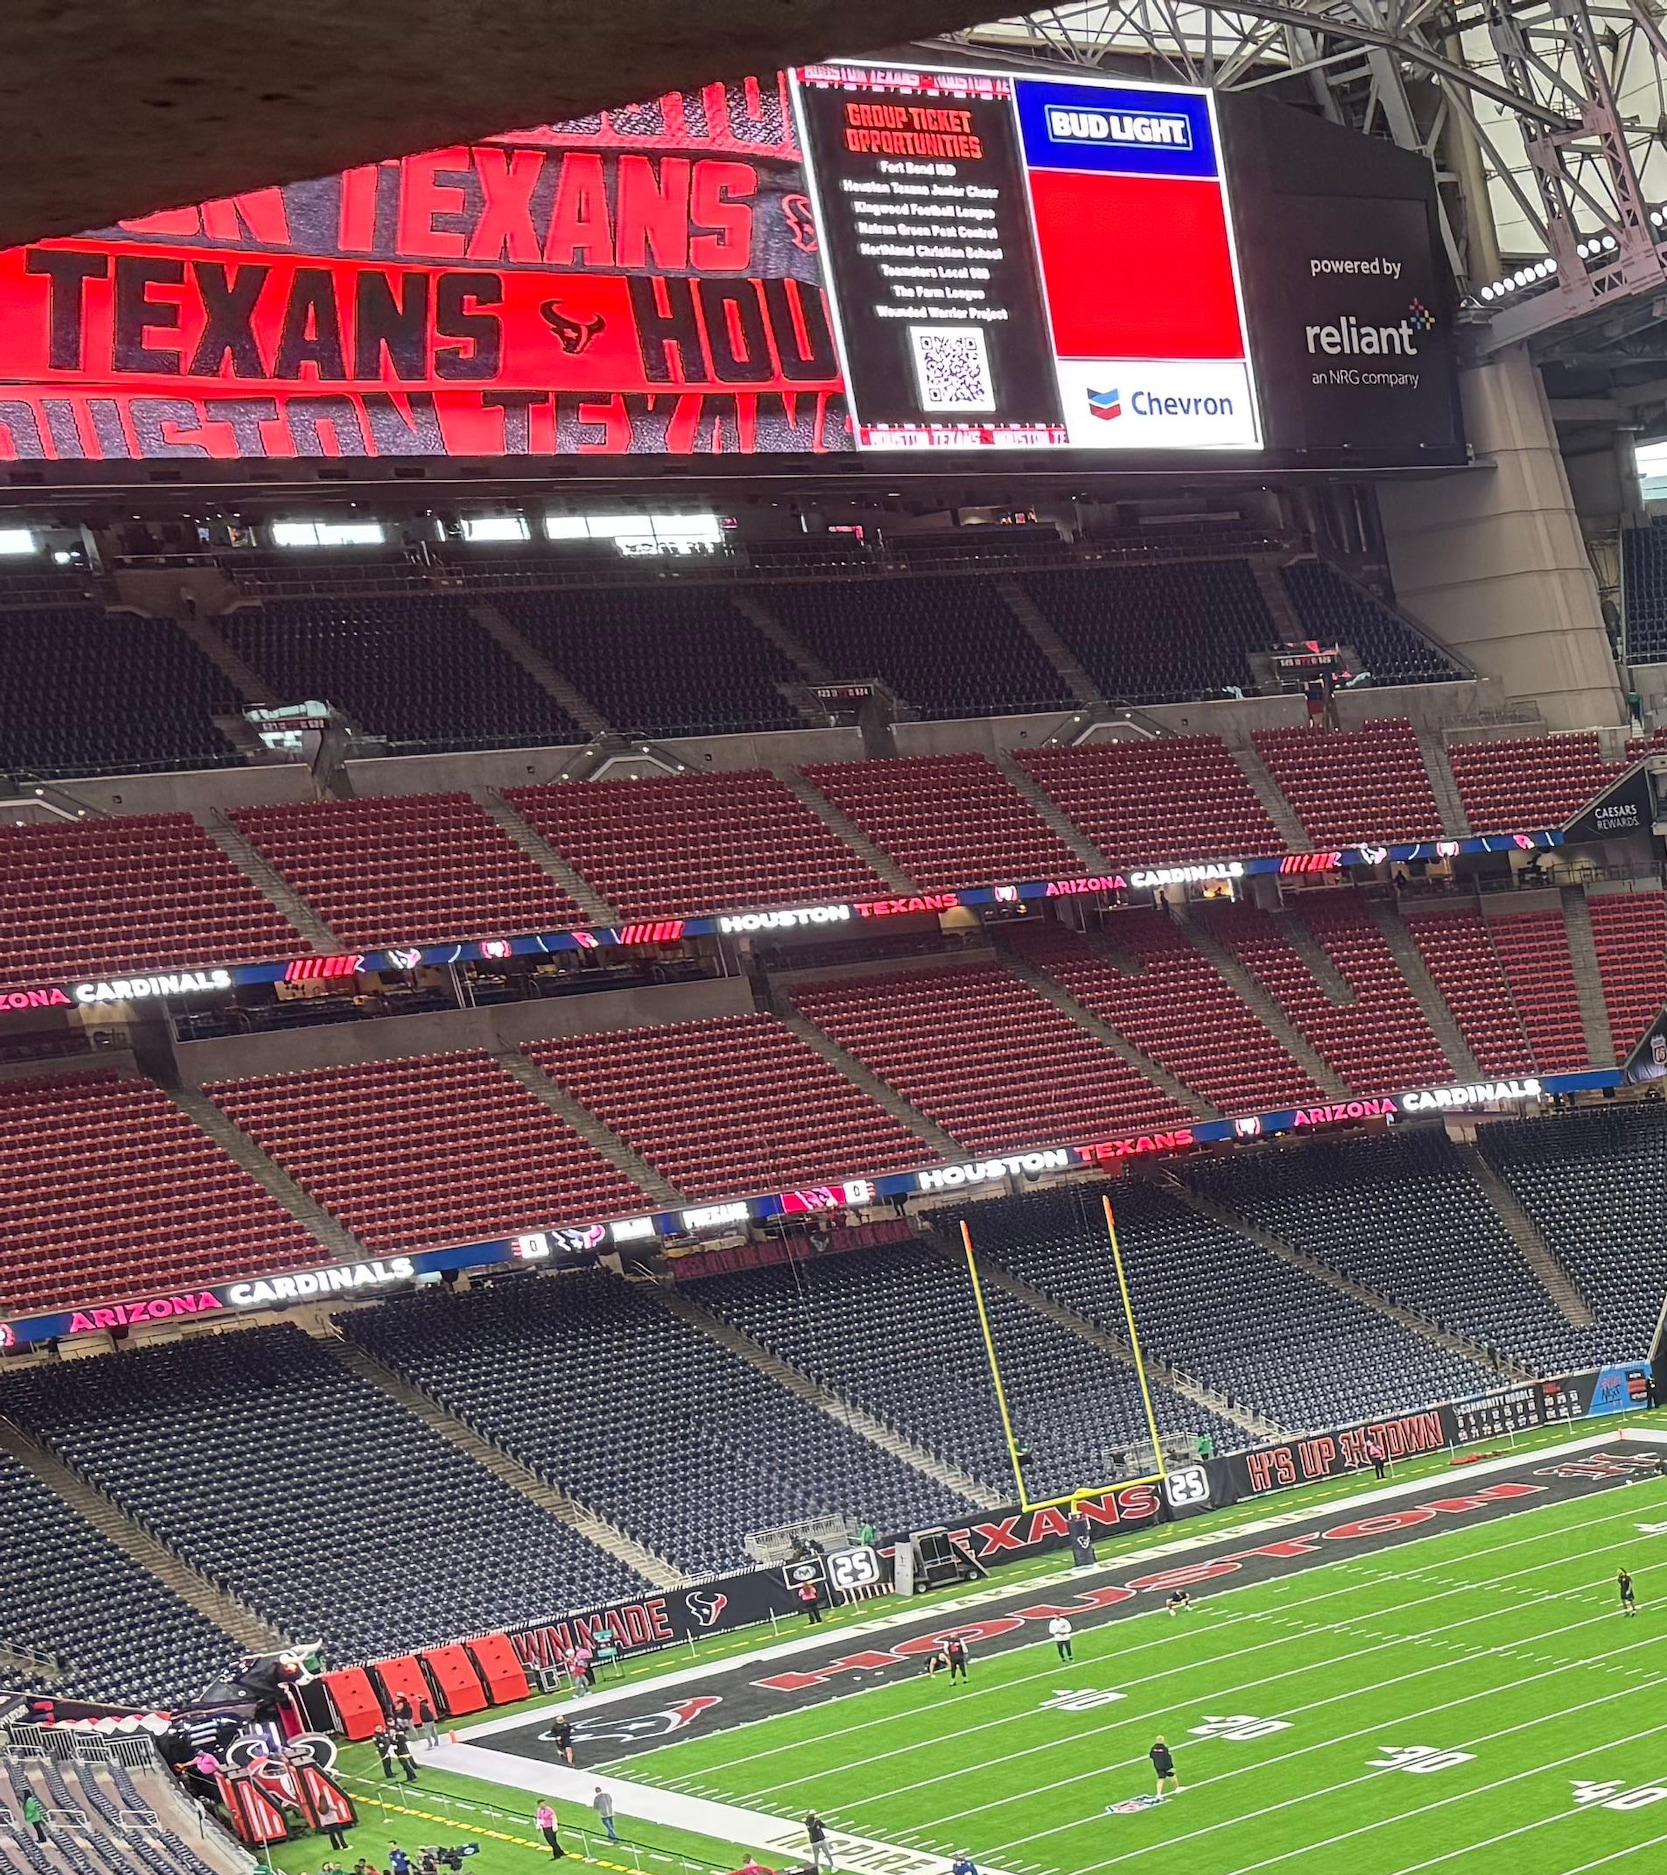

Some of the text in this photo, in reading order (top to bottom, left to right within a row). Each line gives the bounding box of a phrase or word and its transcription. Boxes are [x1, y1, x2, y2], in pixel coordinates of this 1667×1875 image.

[846, 103, 971, 132] GROUP TICKET
[1050, 111, 1110, 139] BUD
[846, 128, 983, 159] OPPORTUNITIES
[1310, 257, 1401, 279] powered by
[893, 285, 915, 298] The
[26, 249, 504, 381] TEXANS
[876, 305, 1008, 321] Wounded Warrior Project
[1306, 316, 1418, 356] reliant
[1311, 370, 1419, 388] an NRG company
[1131, 391, 1233, 416] Chevron
[1594, 803, 1638, 819] CAESARS
[1596, 816, 1640, 830] REWARDS
[1045, 861, 1244, 897] ARIZONA CARDINALS
[720, 893, 960, 934] HOUSTON TEXANS
[76, 970, 232, 1003] CARDINALS
[1293, 1078, 1542, 1127] ARIZONA CARDINALS
[918, 1129, 1194, 1190] HOUSTON TEXANS
[69, 1257, 416, 1334] ARIZONA CARDINALS
[1246, 1446, 1297, 1494] H'S
[1297, 1433, 1336, 1480] UP
[1170, 1471, 1204, 1501] 25
[835, 1552, 873, 1586] 25
[750, 1481, 1549, 1692] HOUSTON
[576, 1599, 675, 1654] MADE
[1366, 1744, 1476, 1774] 30
